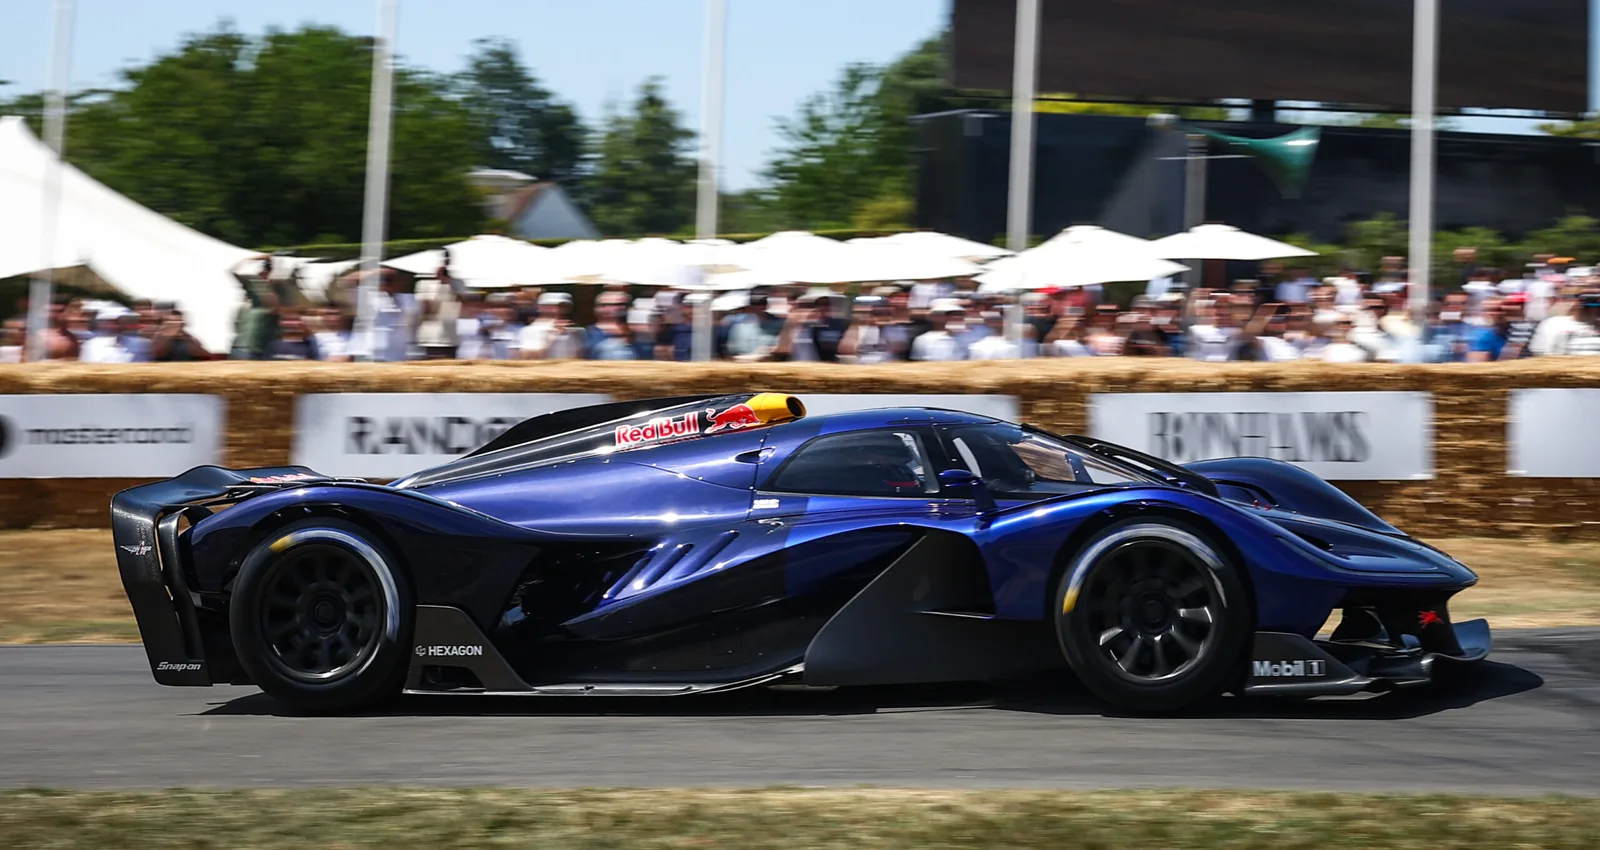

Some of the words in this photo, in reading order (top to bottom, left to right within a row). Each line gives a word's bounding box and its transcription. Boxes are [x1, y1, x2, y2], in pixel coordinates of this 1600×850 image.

[615, 421, 657, 445] Red
[658, 412, 699, 438] Bull
[1148, 411, 1371, 463] BONHAMS
[428, 645, 483, 656] HEXAGON
[156, 661, 202, 672] Snap-on
[1252, 660, 1305, 676] Mobil
